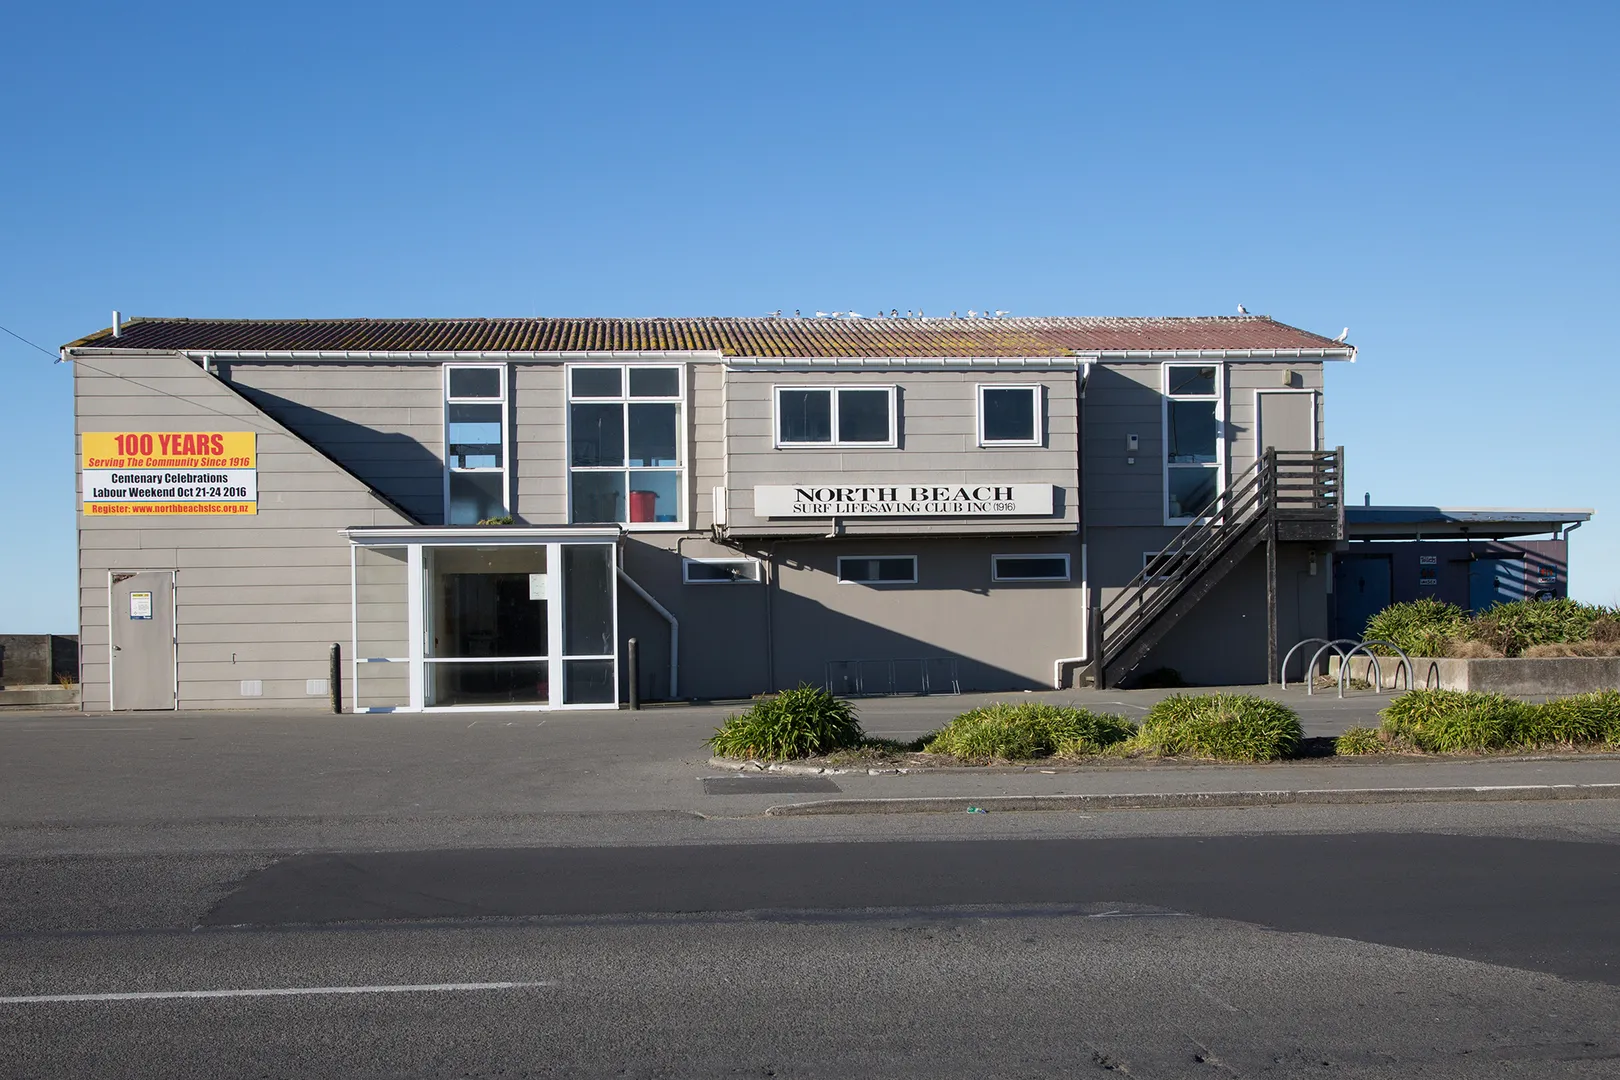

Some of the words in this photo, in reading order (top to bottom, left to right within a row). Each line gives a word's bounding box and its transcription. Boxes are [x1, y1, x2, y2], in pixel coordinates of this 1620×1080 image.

[114, 434, 153, 456] 100
[158, 434, 224, 456] YEARS
[88, 457, 125, 468] Serving
[127, 457, 144, 467] The
[145, 457, 199, 468] Community
[200, 457, 227, 467] Since
[229, 457, 250, 466] 1916
[111, 473, 163, 485] Centenary
[164, 473, 229, 484] Celebrations
[93, 487, 127, 498] Labour
[129, 487, 175, 498] Weekend
[177, 487, 194, 497] Oct
[195, 487, 222, 497] 21-24
[223, 487, 247, 497] 2016
[793, 487, 898, 503] NORTH
[909, 486, 1015, 502] BEACH
[92, 504, 131, 514] Register:
[132, 504, 249, 514] www.northbeachslsc.org.nz
[792, 502, 832, 514] SURF
[836, 502, 921, 513] LIFESAVING
[924, 502, 963, 513] CLUB
[967, 502, 992, 512] INC
[992, 502, 1016, 512] (1916)
